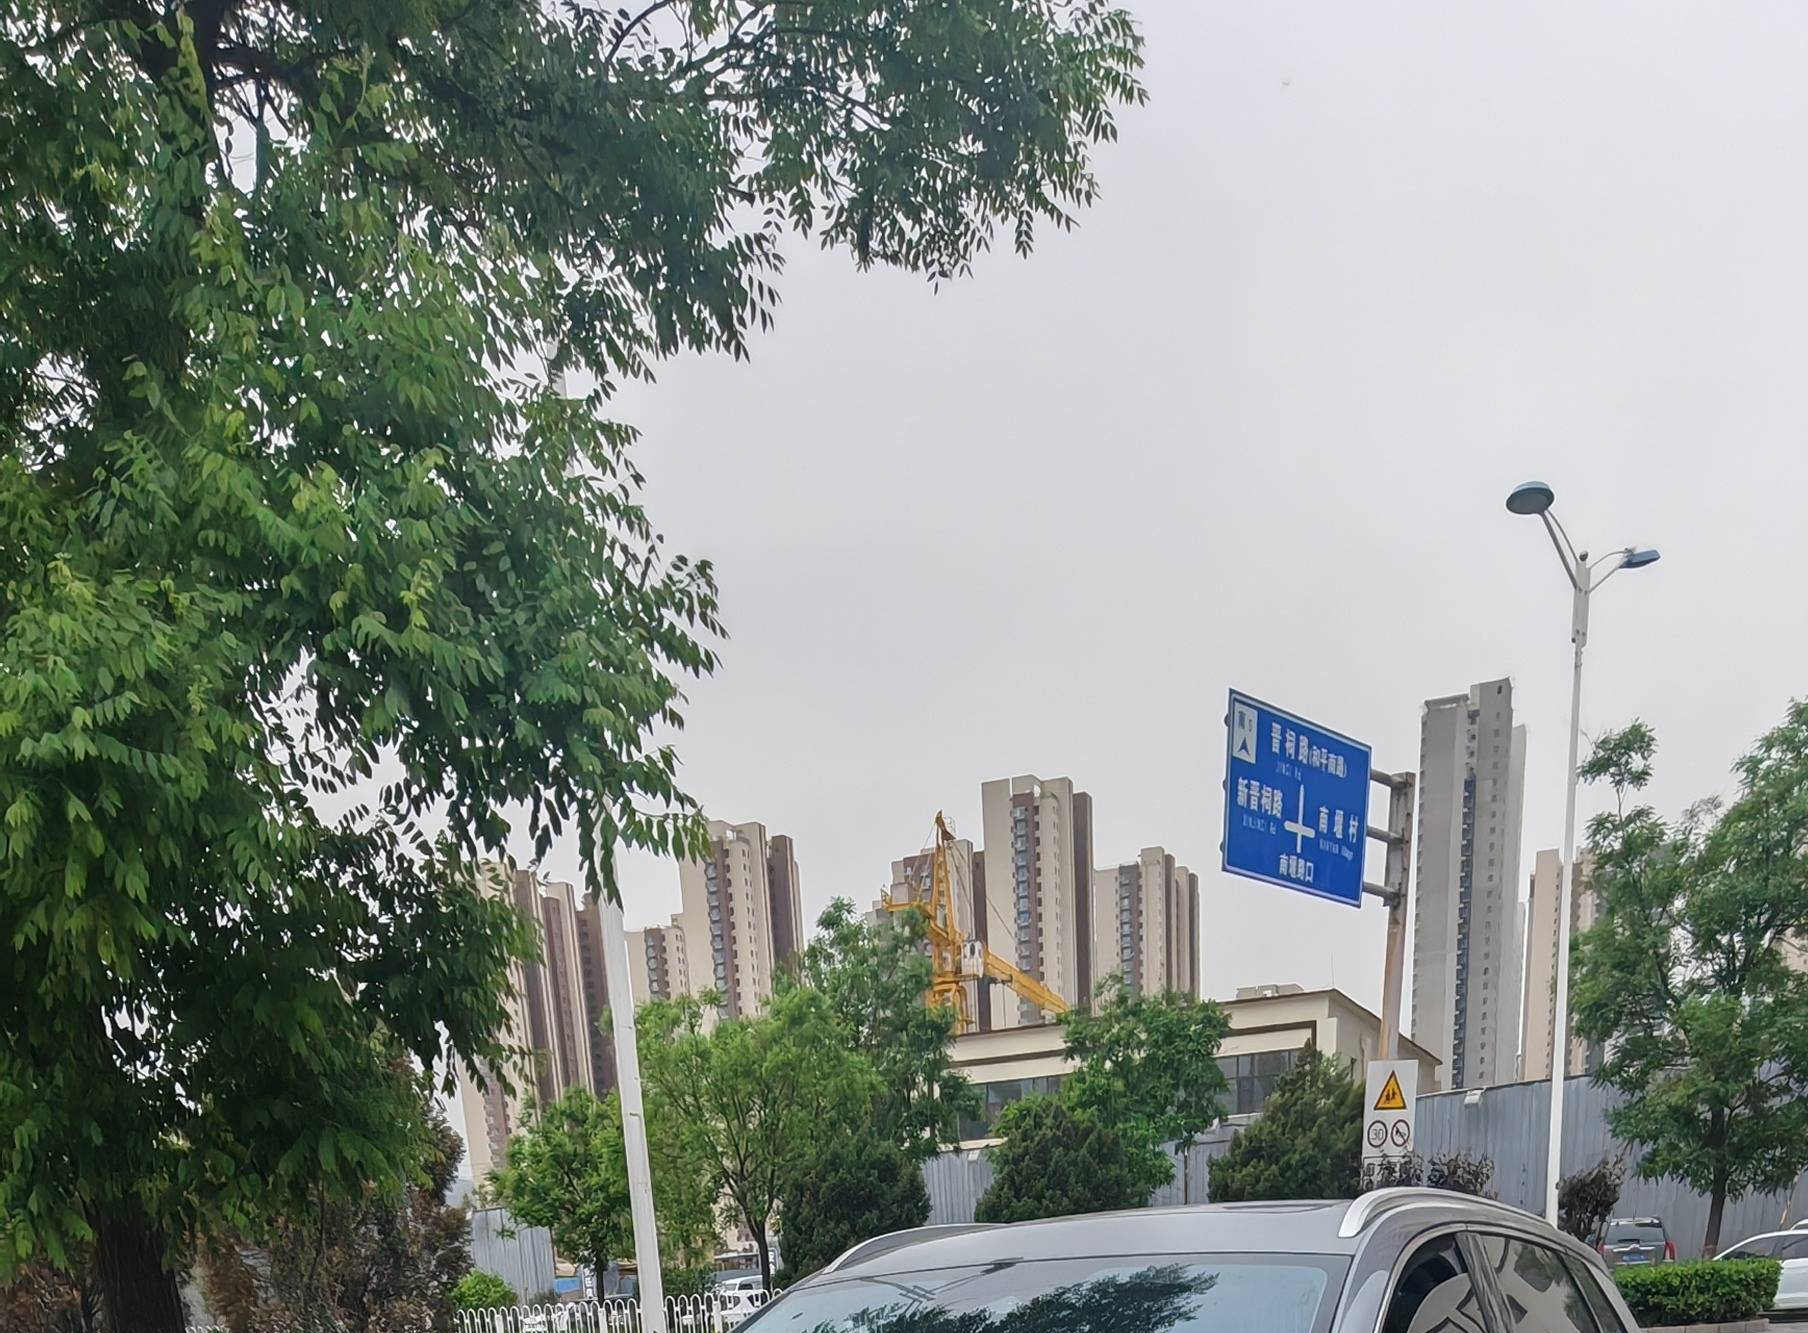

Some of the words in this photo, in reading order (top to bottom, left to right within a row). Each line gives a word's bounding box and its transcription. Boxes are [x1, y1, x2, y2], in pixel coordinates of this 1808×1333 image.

[1237, 776, 1283, 819] 新晋祠路
[1371, 1128, 1385, 1141] 30
